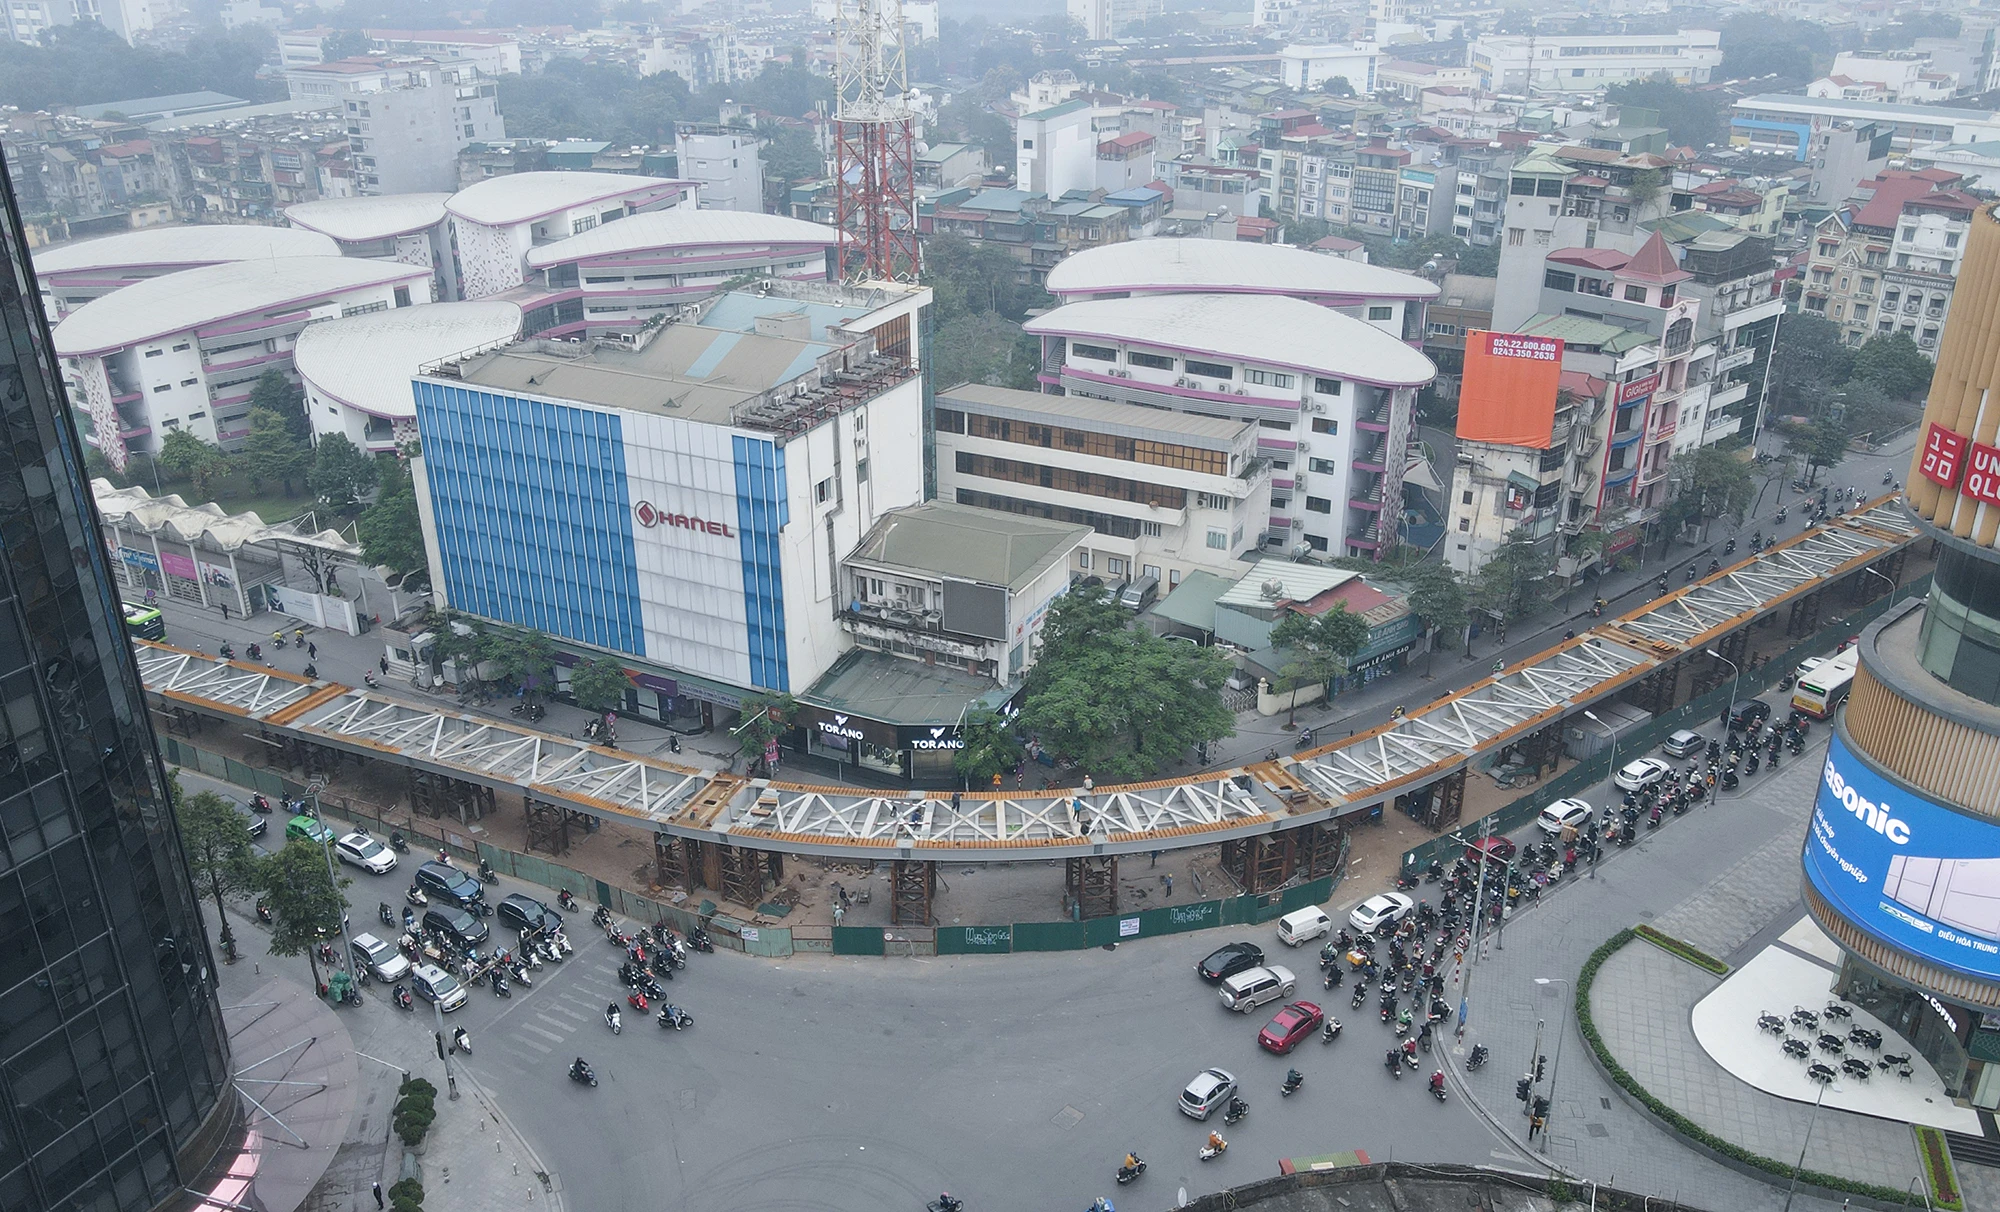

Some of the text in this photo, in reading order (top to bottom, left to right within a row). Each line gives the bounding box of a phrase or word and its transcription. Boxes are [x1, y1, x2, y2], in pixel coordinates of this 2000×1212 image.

[1493, 338, 1556, 352] 024.22.600.600
[658, 511, 735, 539] HANEL
[1396, 645, 1409, 656] SAO
[818, 721, 864, 741] TORANO
[911, 739, 965, 749] TORANO
[1839, 856, 1868, 884] nghiệp
[1955, 935, 1972, 949] HÒA
[1972, 941, 1998, 954] TRUNG
[1930, 997, 1957, 1033] COFFEE
